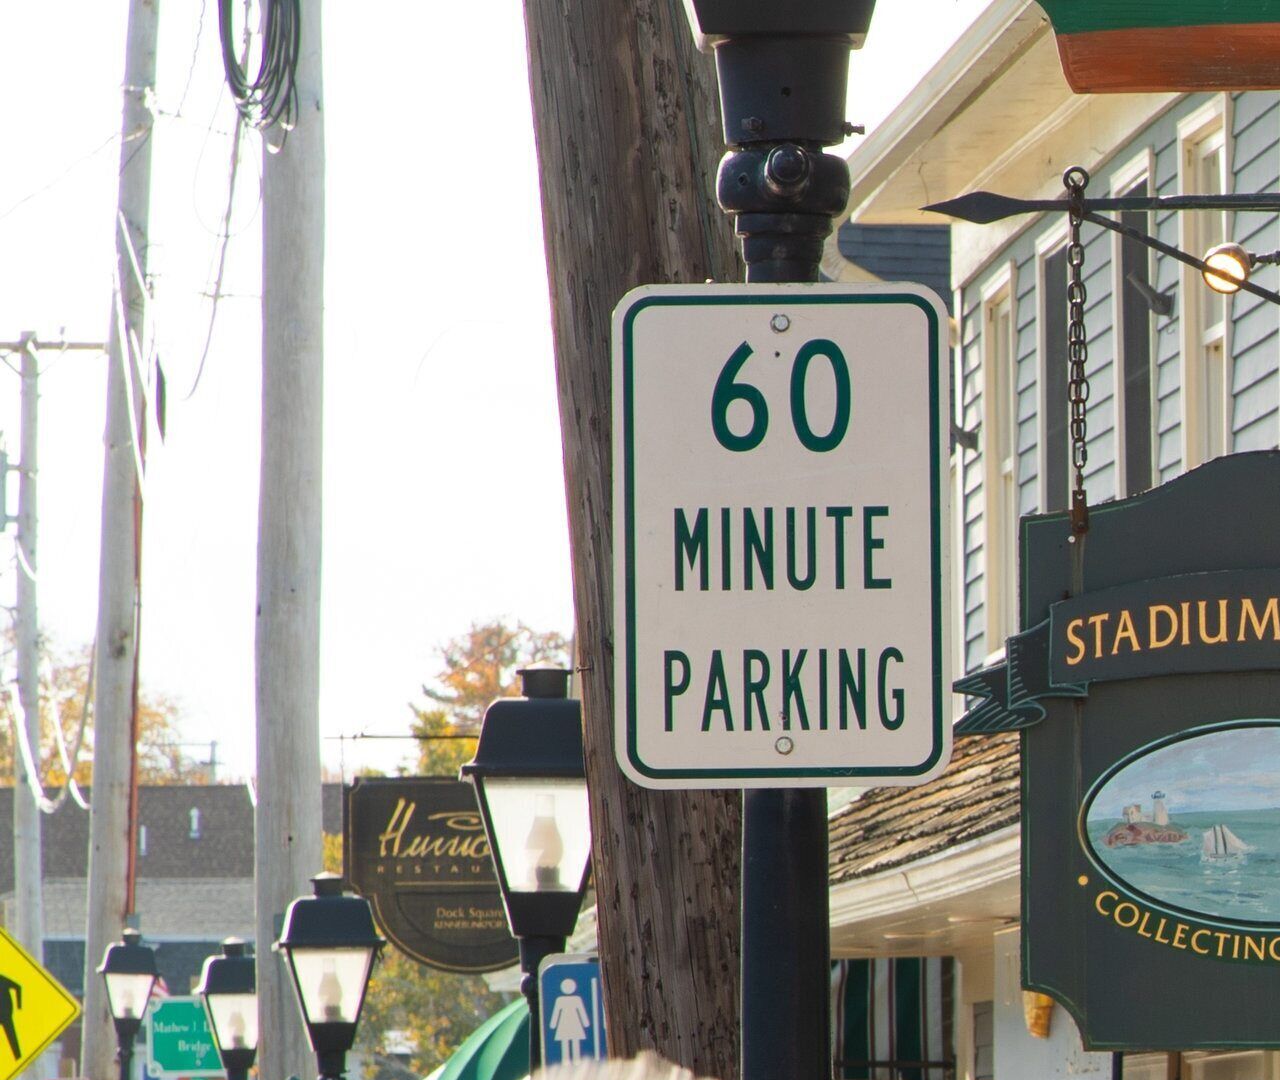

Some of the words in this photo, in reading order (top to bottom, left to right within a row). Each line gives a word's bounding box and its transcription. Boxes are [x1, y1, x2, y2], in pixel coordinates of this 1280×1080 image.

[711, 338, 851, 453] 60
[674, 505, 893, 592] MINUTE
[664, 647, 905, 733] PARKING
[377, 864, 498, 875] RESTAU
[435, 907, 465, 918] Dock
[178, 1040, 211, 1058] Bridge
